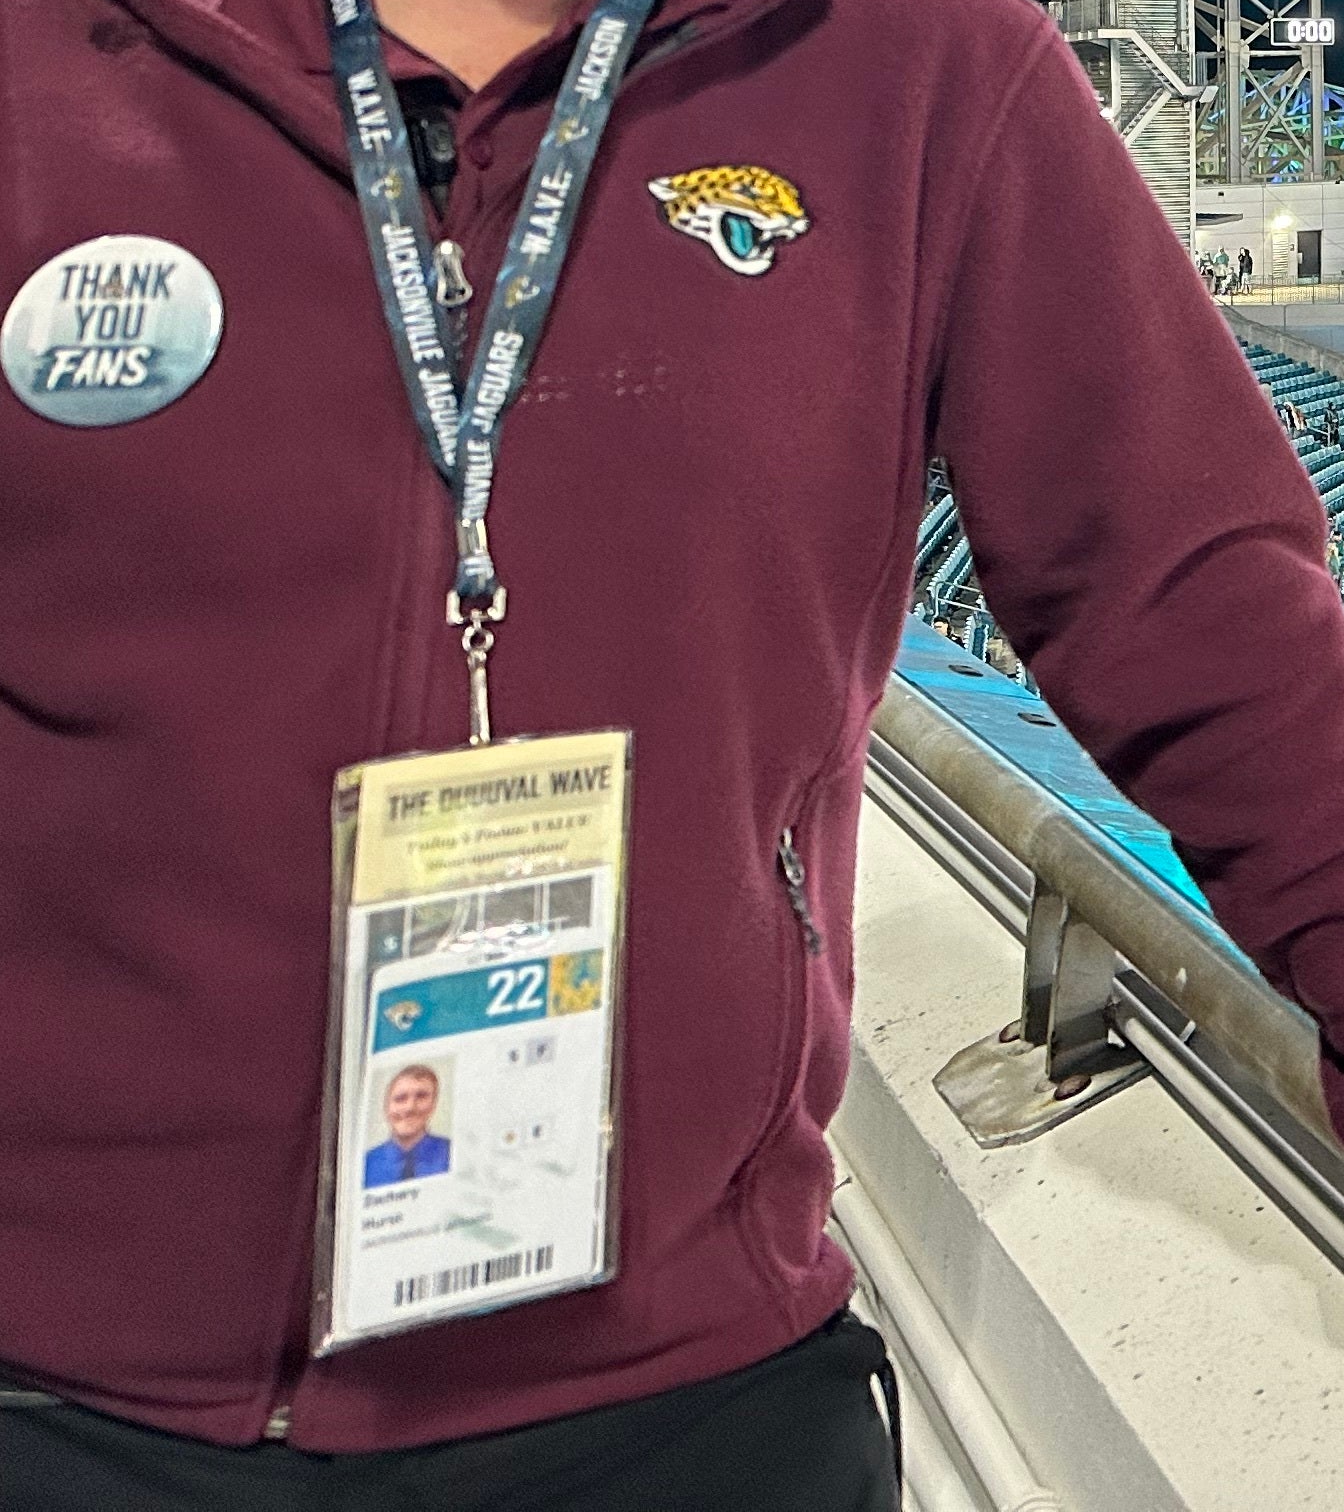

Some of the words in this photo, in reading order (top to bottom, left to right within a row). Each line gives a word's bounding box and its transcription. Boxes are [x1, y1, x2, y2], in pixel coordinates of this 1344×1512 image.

[1288, 21, 1331, 42] 0:00
[575, 17, 628, 101] JACKSON
[61, 263, 175, 300] THANK
[381, 222, 445, 364] JACKSONVILLE
[75, 304, 144, 340] YOU
[47, 346, 151, 390] FANS
[471, 330, 524, 434] JAGUARS
[388, 789, 430, 822] THE
[551, 764, 612, 794] WAVE
[486, 964, 545, 1017] 22
